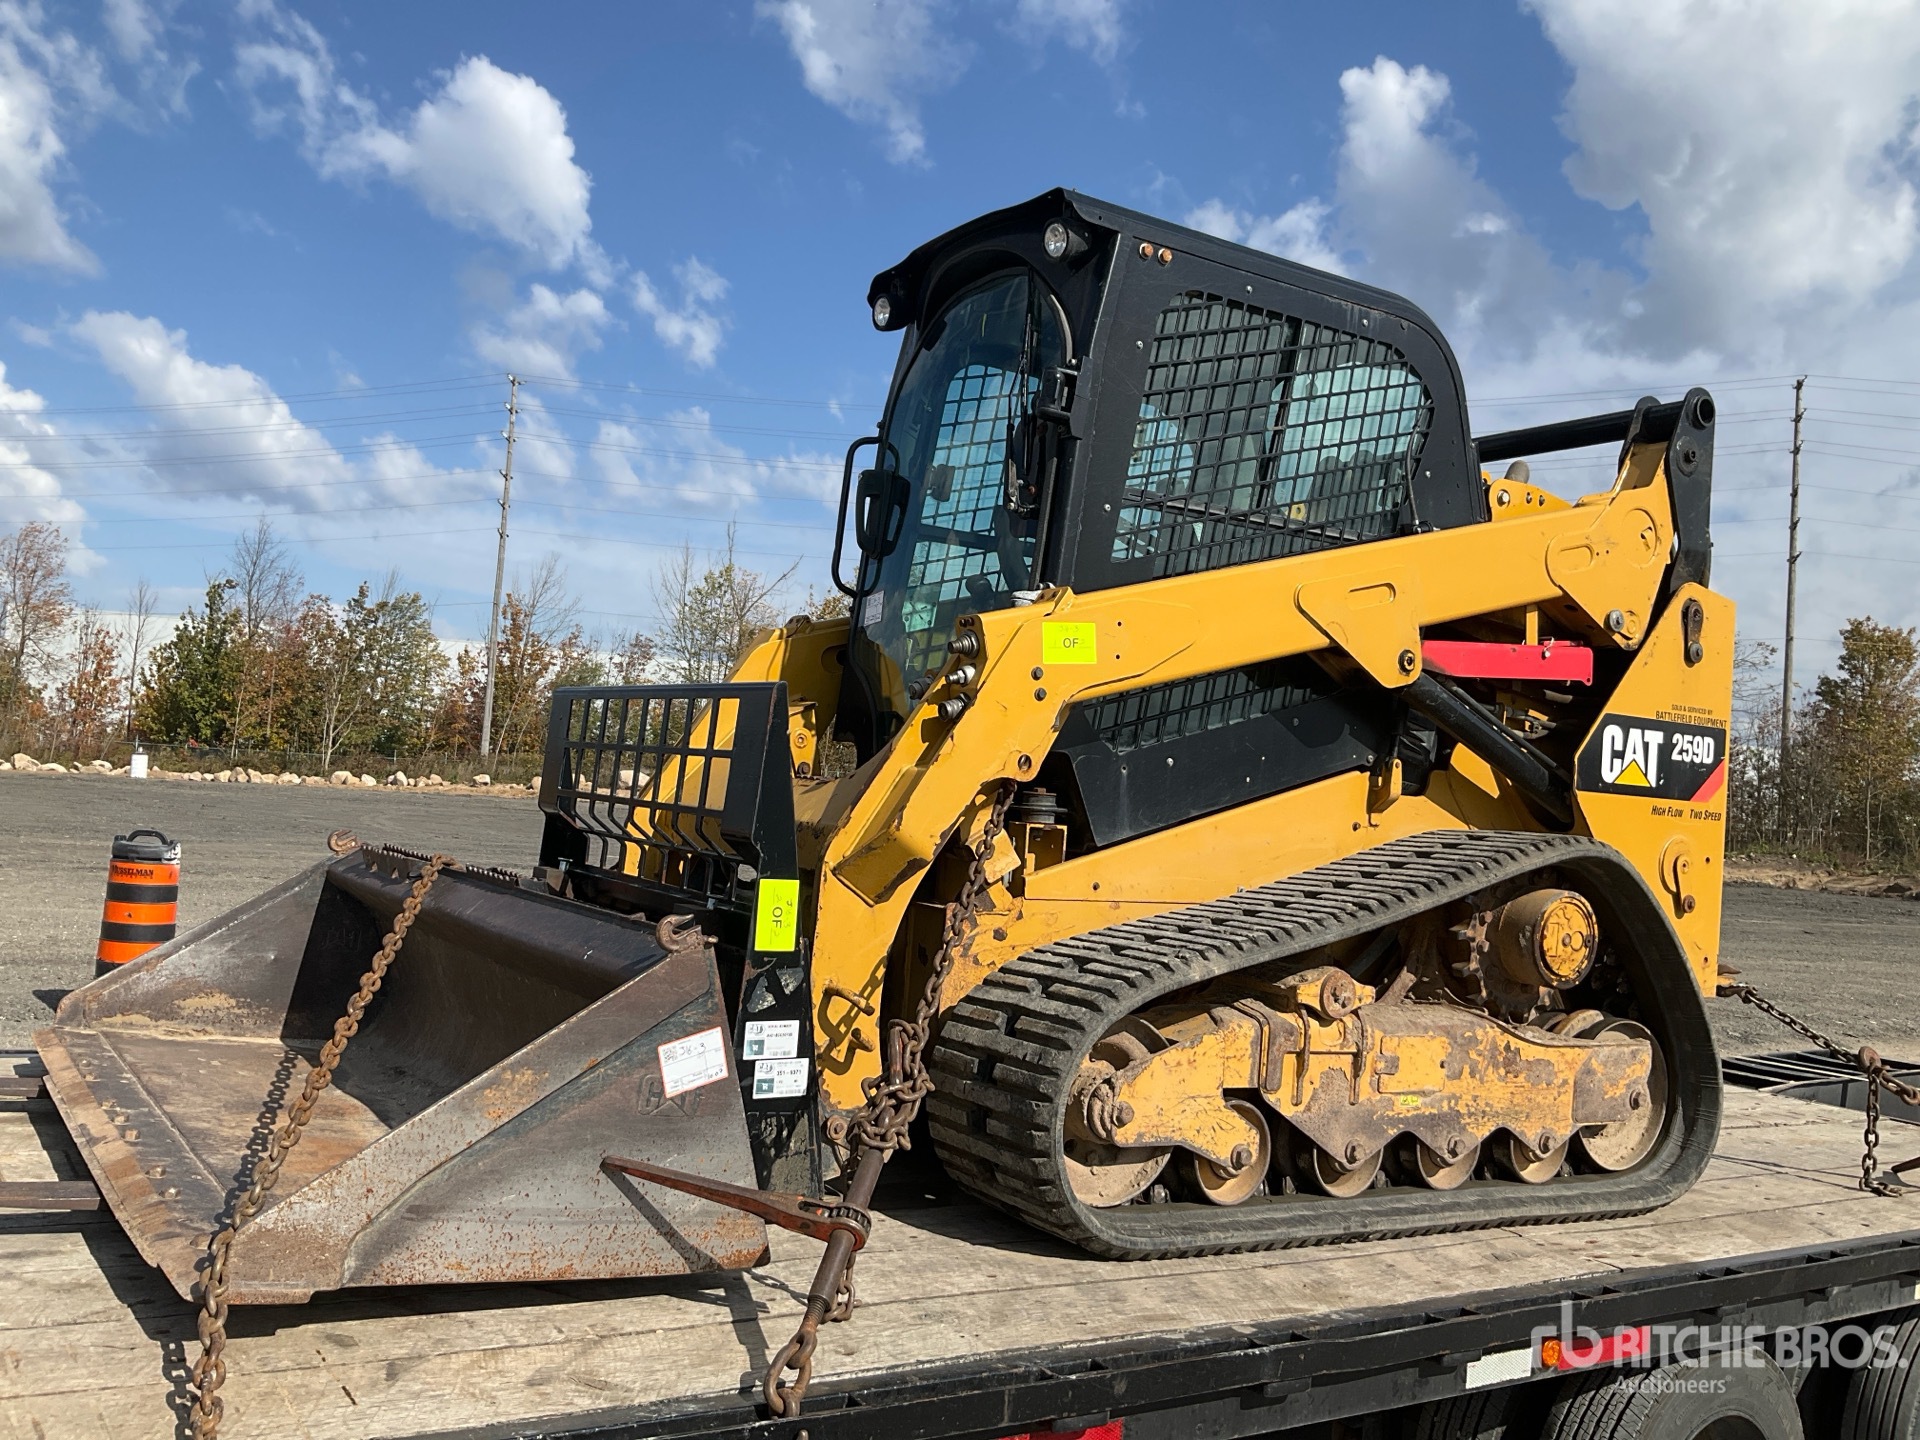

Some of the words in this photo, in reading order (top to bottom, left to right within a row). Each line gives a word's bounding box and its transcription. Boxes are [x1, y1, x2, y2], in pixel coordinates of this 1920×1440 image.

[1062, 637, 1079, 649] OF
[1671, 703, 1683, 712] SOLD
[1687, 706, 1707, 714] SERVICED
[1655, 710, 1693, 724] BATTLEFIELD
[1693, 715, 1727, 728] EQUIPMENT
[1601, 724, 1664, 788] CAT
[1671, 732, 1715, 765] 259D
[772, 906, 783, 929] OF
